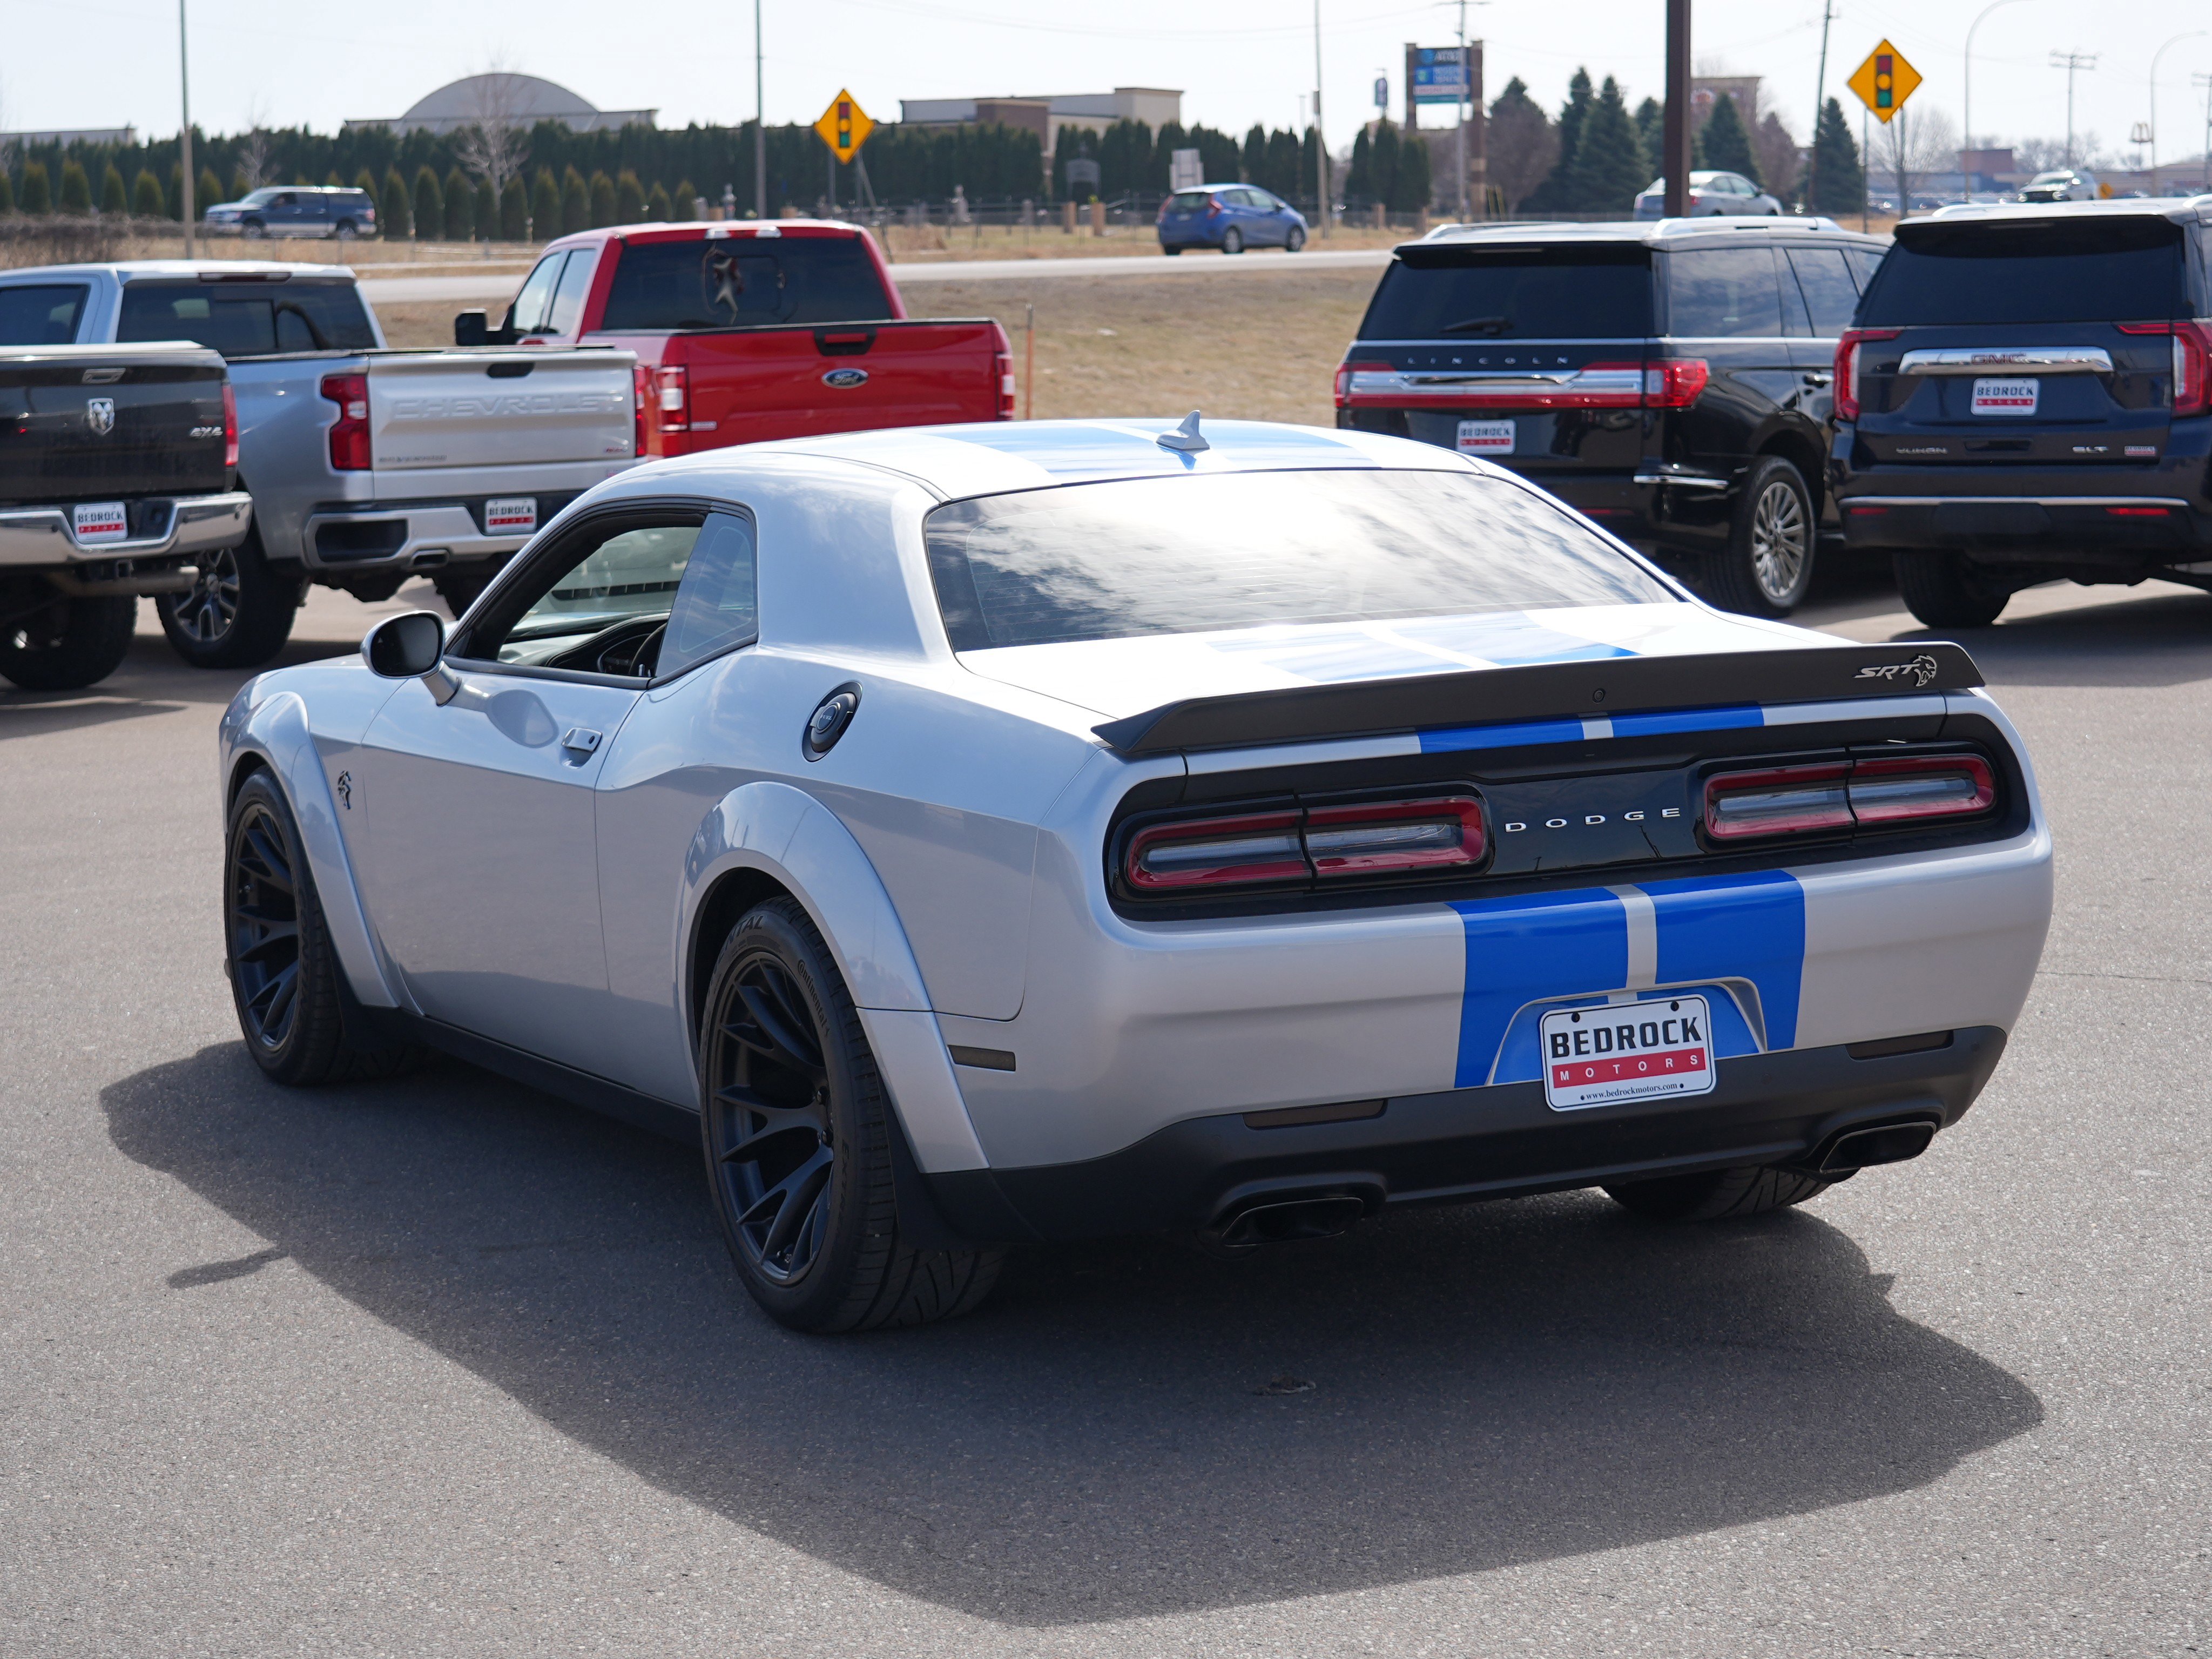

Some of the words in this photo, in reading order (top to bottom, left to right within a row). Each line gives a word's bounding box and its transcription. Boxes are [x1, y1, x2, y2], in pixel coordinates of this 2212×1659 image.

[1407, 356, 1569, 366] LINCOLN
[1971, 353, 2027, 365] GMC
[1977, 386, 2033, 396] BEDROCK
[395, 394, 624, 419] CHEVROLET
[1460, 427, 1510, 436] BEDROCK
[78, 510, 124, 523] BEDROCK
[490, 505, 533, 515] BEDROCK
[1853, 664, 1920, 679] SRT
[1505, 808, 1681, 832] DODGE
[798, 959, 828, 1028] Continental
[1550, 1016, 1702, 1058] BEDROCK
[1560, 1054, 1698, 1081] MOTORS
[1586, 1082, 1678, 1100] www.bedrockmotors.com
